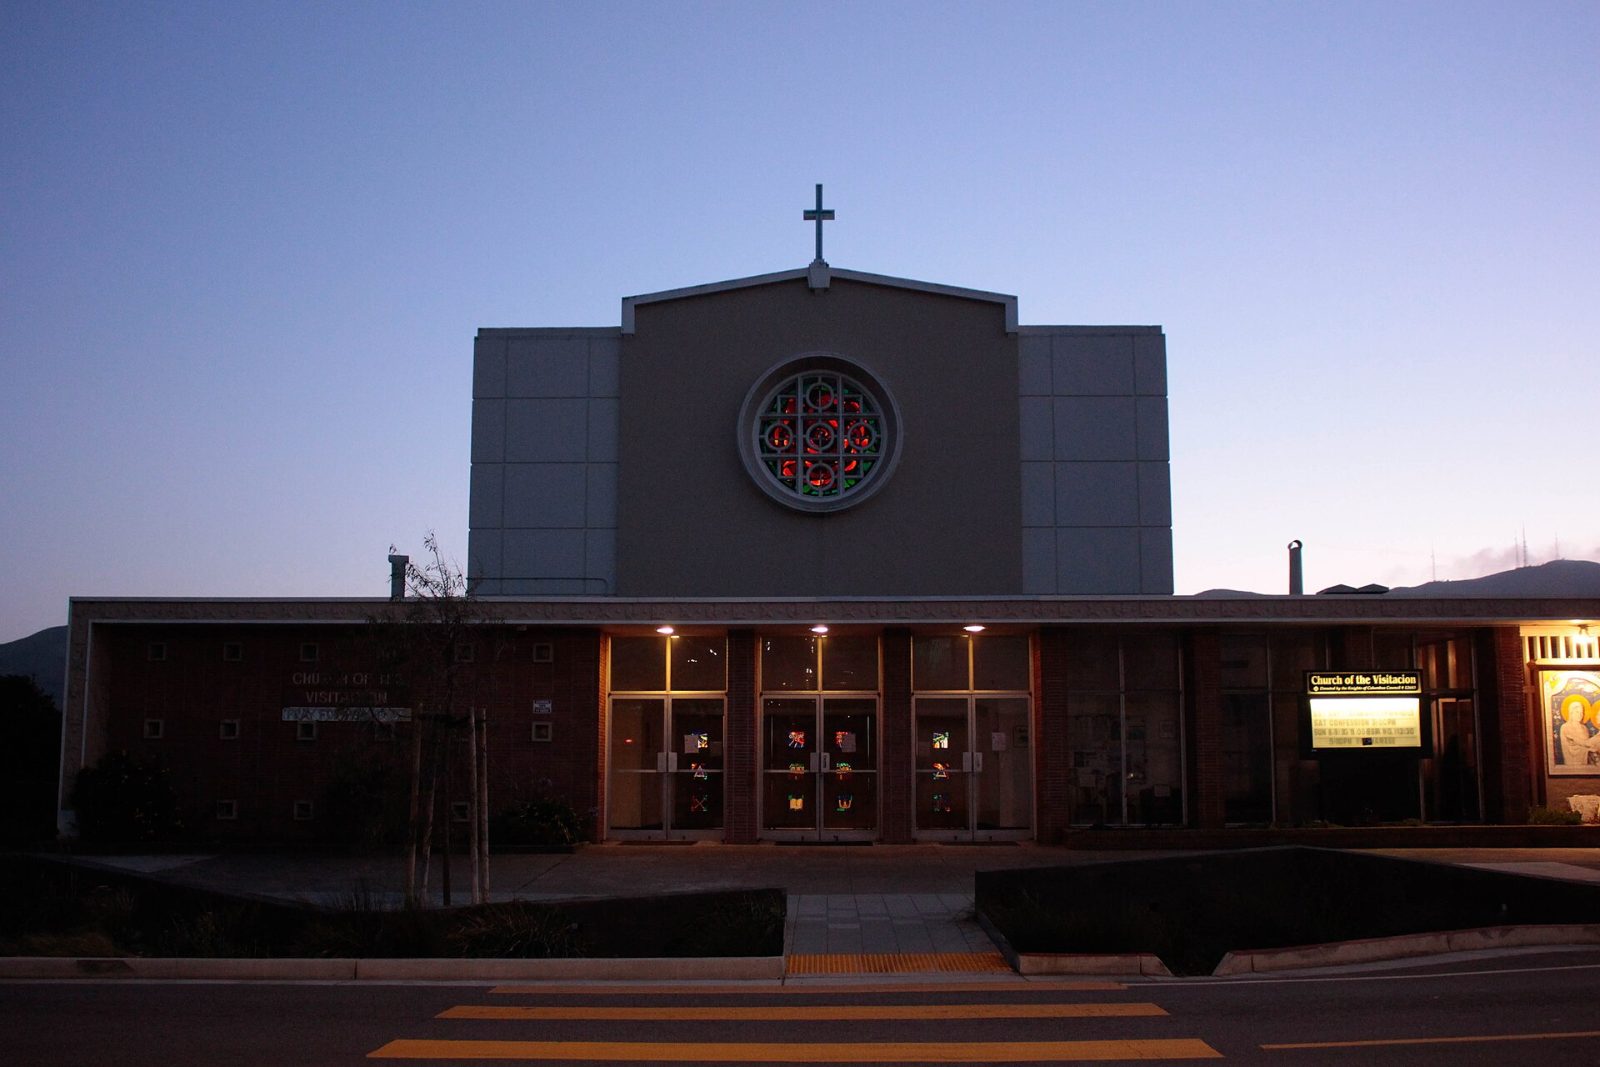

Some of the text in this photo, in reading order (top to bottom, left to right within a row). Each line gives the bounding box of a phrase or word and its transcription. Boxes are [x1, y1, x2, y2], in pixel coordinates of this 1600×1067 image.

[292, 672, 348, 685] CHUH
[1311, 674, 1417, 685] Church of the Visitacion
